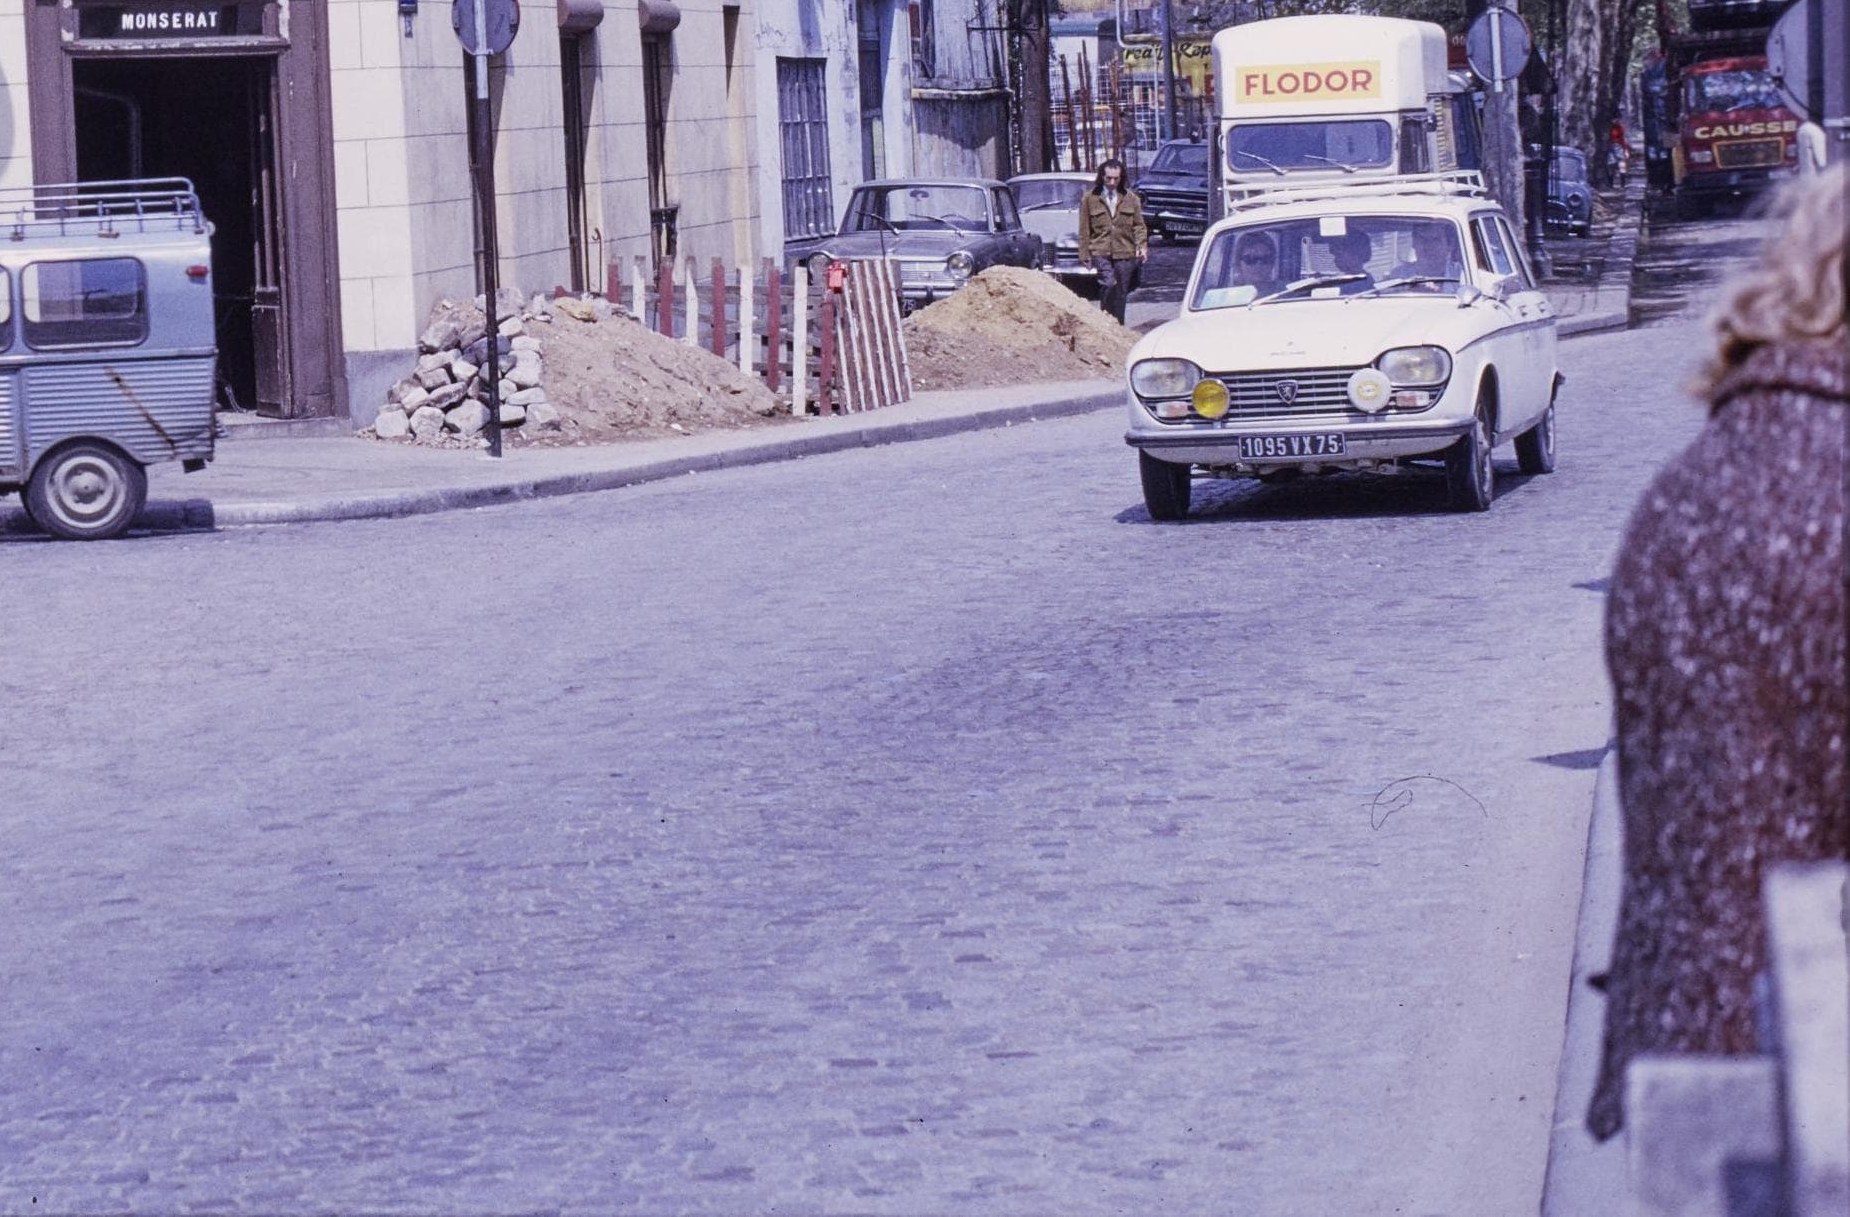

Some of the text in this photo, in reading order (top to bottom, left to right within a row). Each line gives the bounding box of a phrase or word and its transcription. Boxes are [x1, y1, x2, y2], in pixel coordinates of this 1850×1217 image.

[121, 11, 218, 30] MONSERAT
[1245, 69, 1372, 96] FLODOR
[1694, 120, 1798, 139] CAUSSE
[1245, 435, 1339, 456] 1095 VX 75
